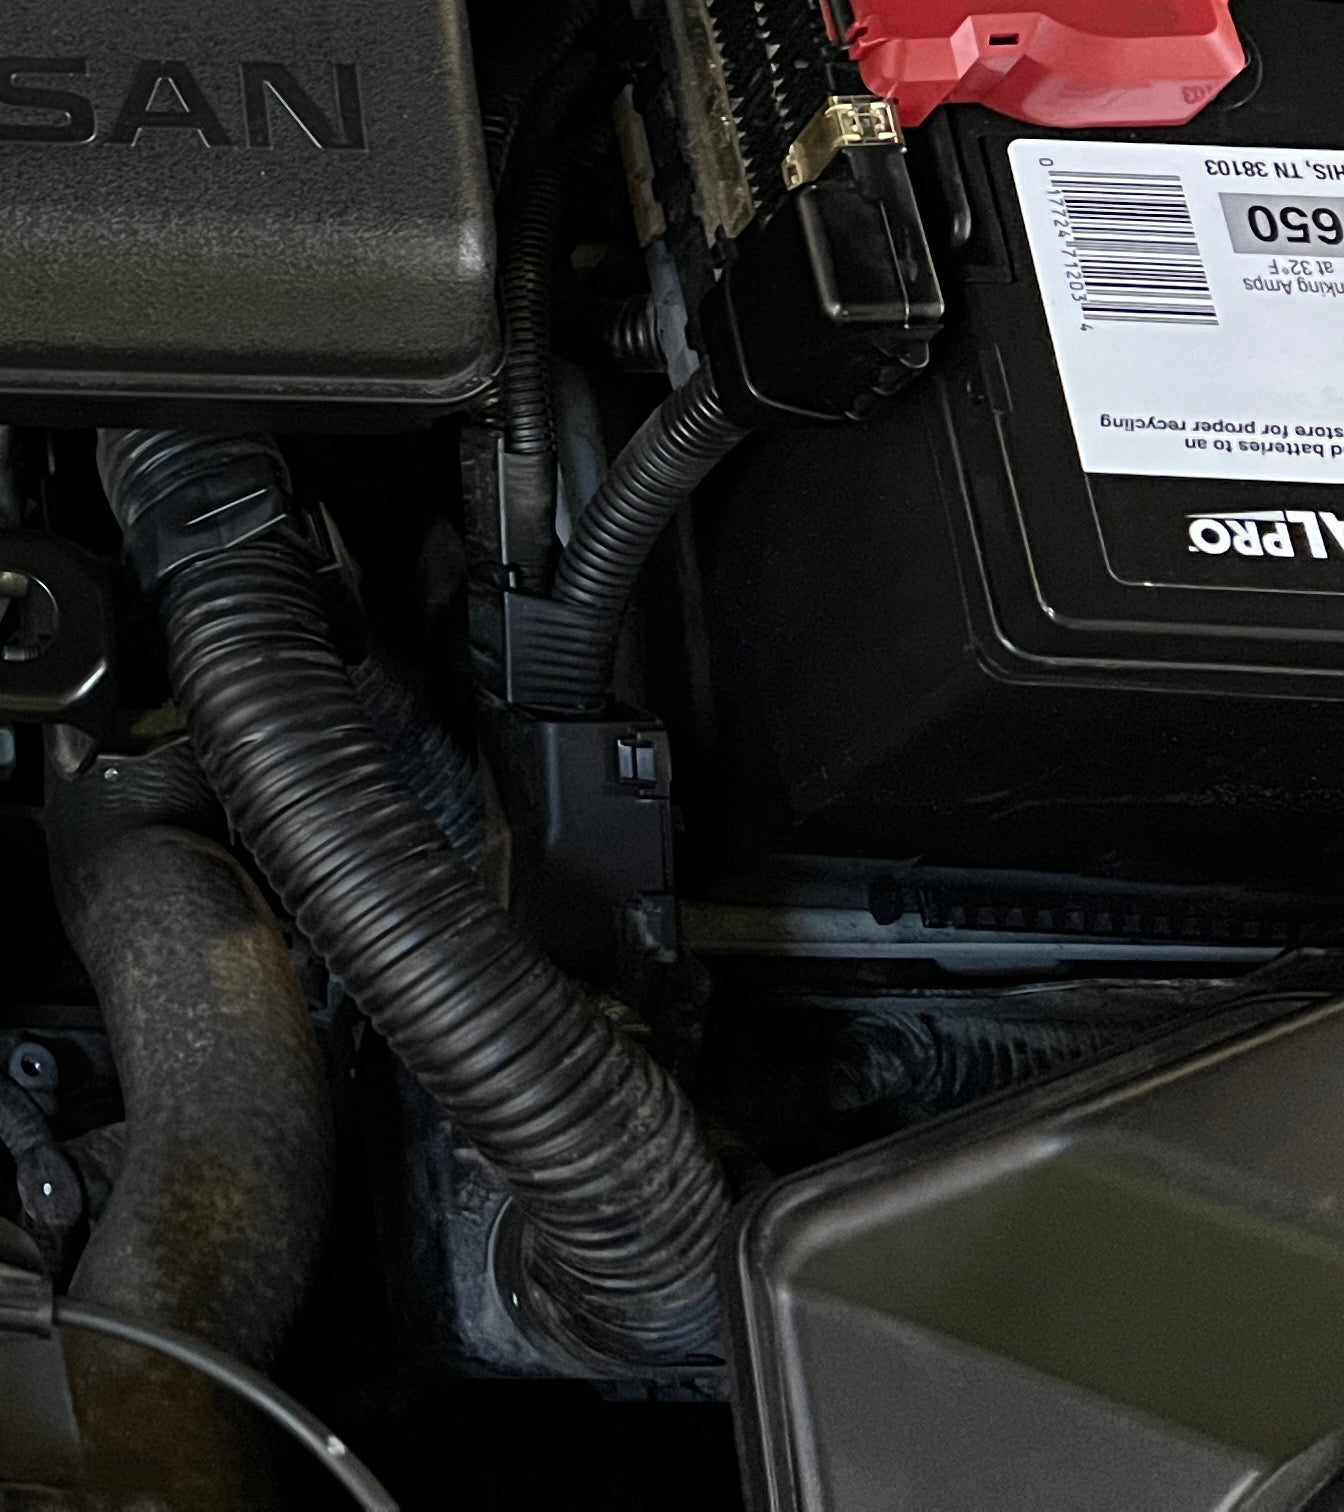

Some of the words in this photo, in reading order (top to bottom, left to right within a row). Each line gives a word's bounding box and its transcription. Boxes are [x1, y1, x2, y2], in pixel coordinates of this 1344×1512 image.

[1205, 159, 1268, 177] 38103
[1273, 162, 1304, 179] TN
[1247, 205, 1344, 245] 650
[1315, 260, 1335, 275] at
[1243, 275, 1292, 295] Amps
[1100, 413, 1186, 432] recycling
[1192, 419, 1256, 435] proper
[1261, 424, 1288, 439] for
[1184, 438, 1208, 449] an
[1213, 439, 1233, 453] to
[1238, 440, 1324, 458] batteries
